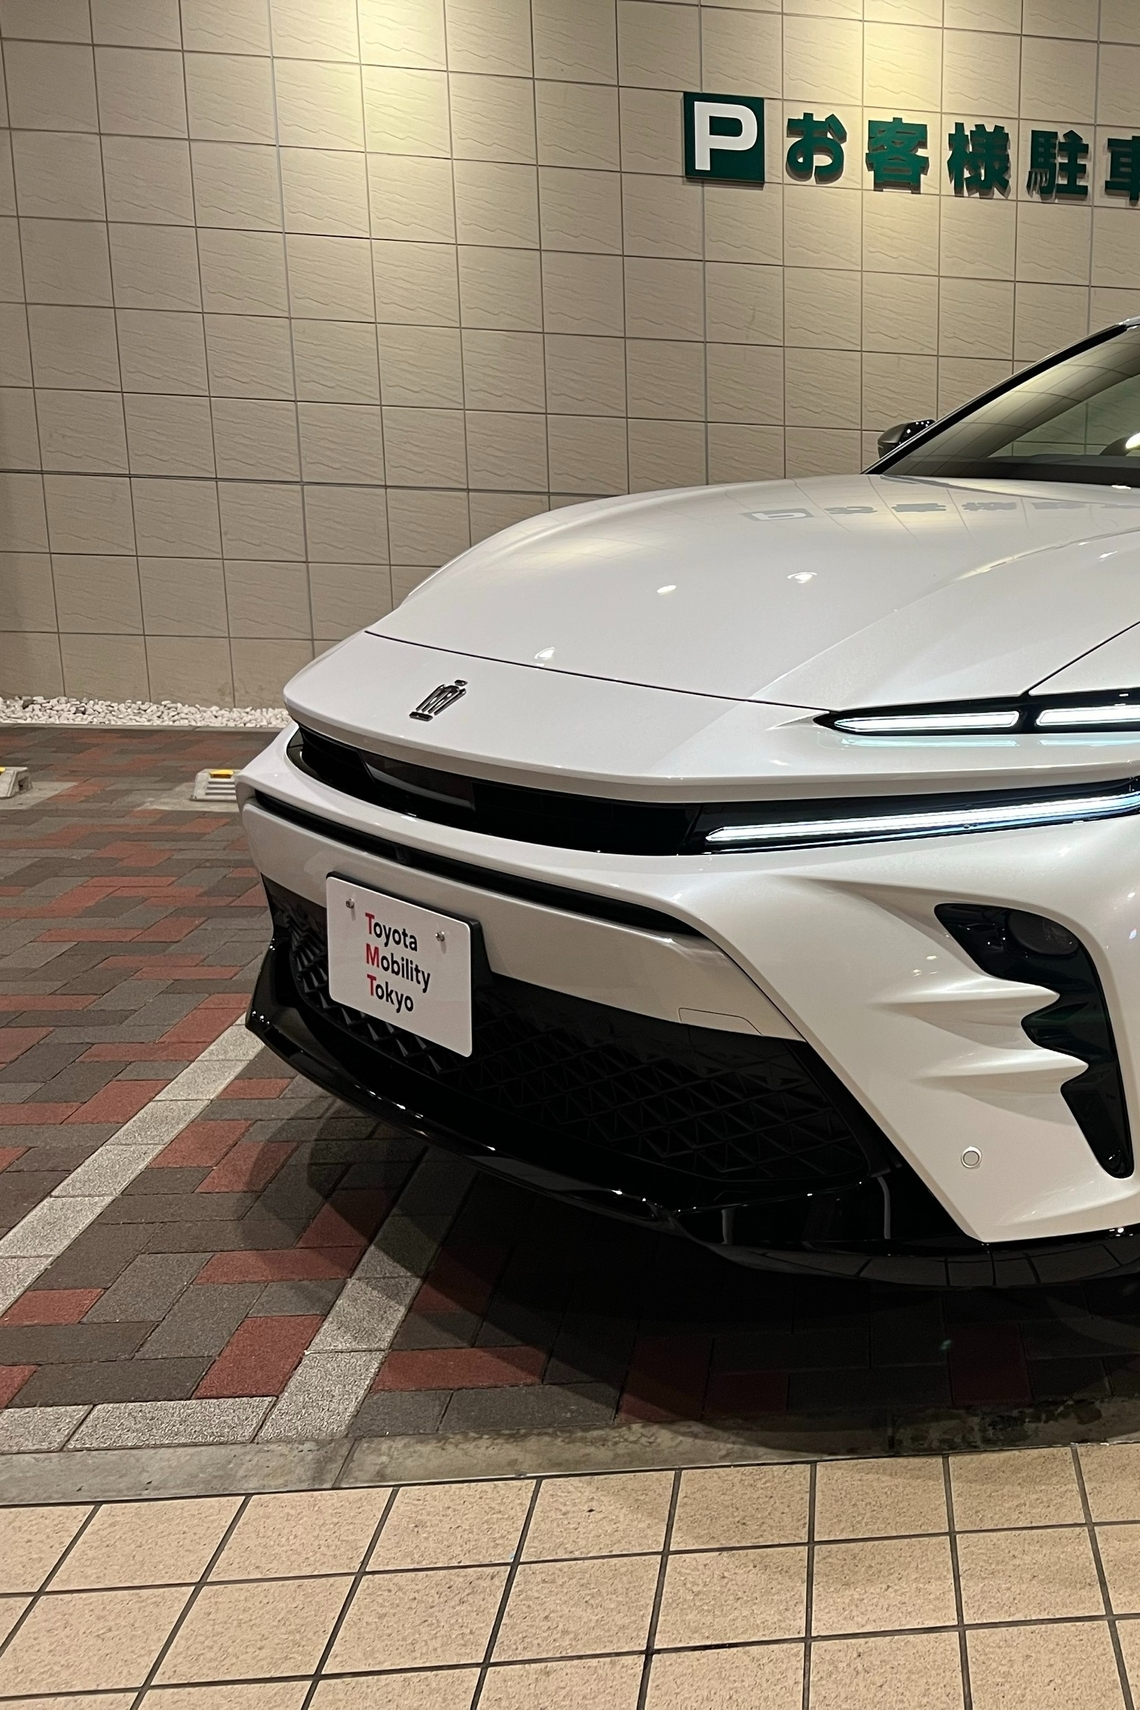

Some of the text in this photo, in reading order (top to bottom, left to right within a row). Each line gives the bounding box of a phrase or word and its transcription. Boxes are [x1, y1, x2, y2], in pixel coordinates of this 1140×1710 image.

[692, 100, 759, 171] P
[365, 912, 418, 952] Toyota
[365, 942, 431, 994] Mobility
[366, 973, 414, 1014] Tokyo
